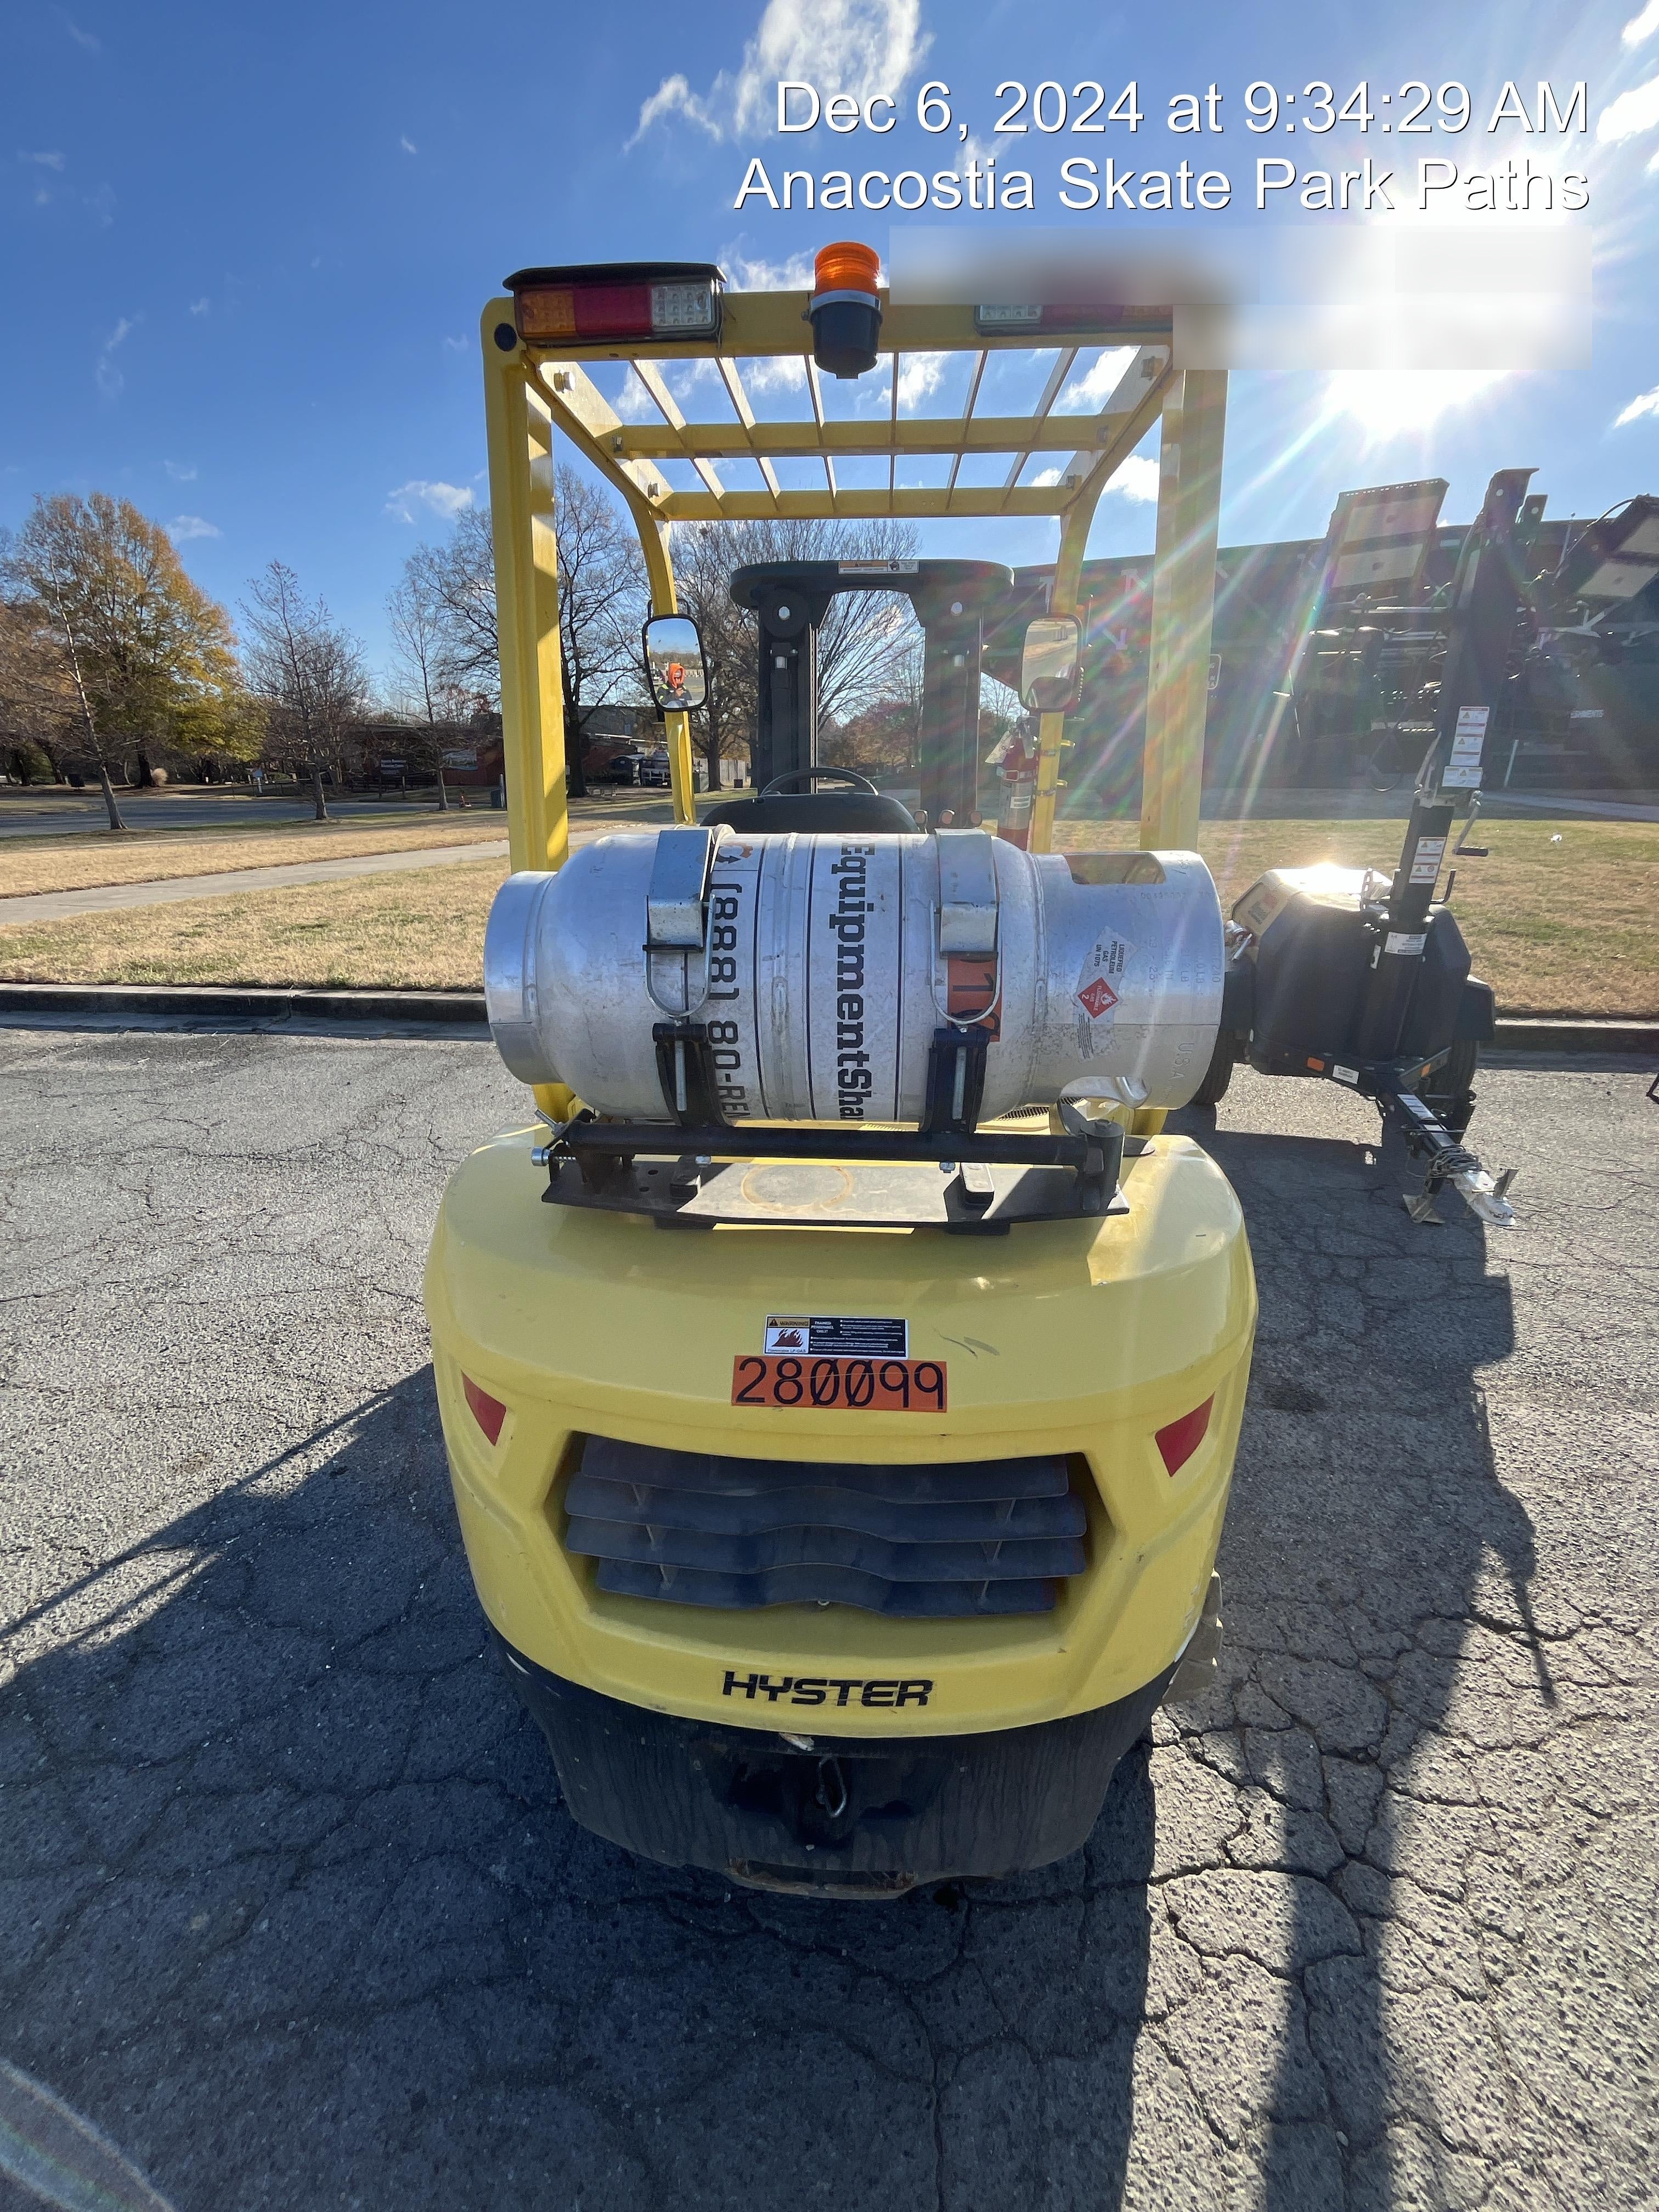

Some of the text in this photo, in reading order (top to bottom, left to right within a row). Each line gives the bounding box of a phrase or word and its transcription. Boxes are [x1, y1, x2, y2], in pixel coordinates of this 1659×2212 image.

[1093, 944, 1102, 967] UN 1075
[1108, 940, 1118, 974] PETROLEUM
[1116, 944, 1125, 972] LIQUEFIED
[830, 843, 875, 1120] EquipmentSha
[736, 1357, 944, 1409] 280099
[722, 1671, 934, 1707] HYSTER
